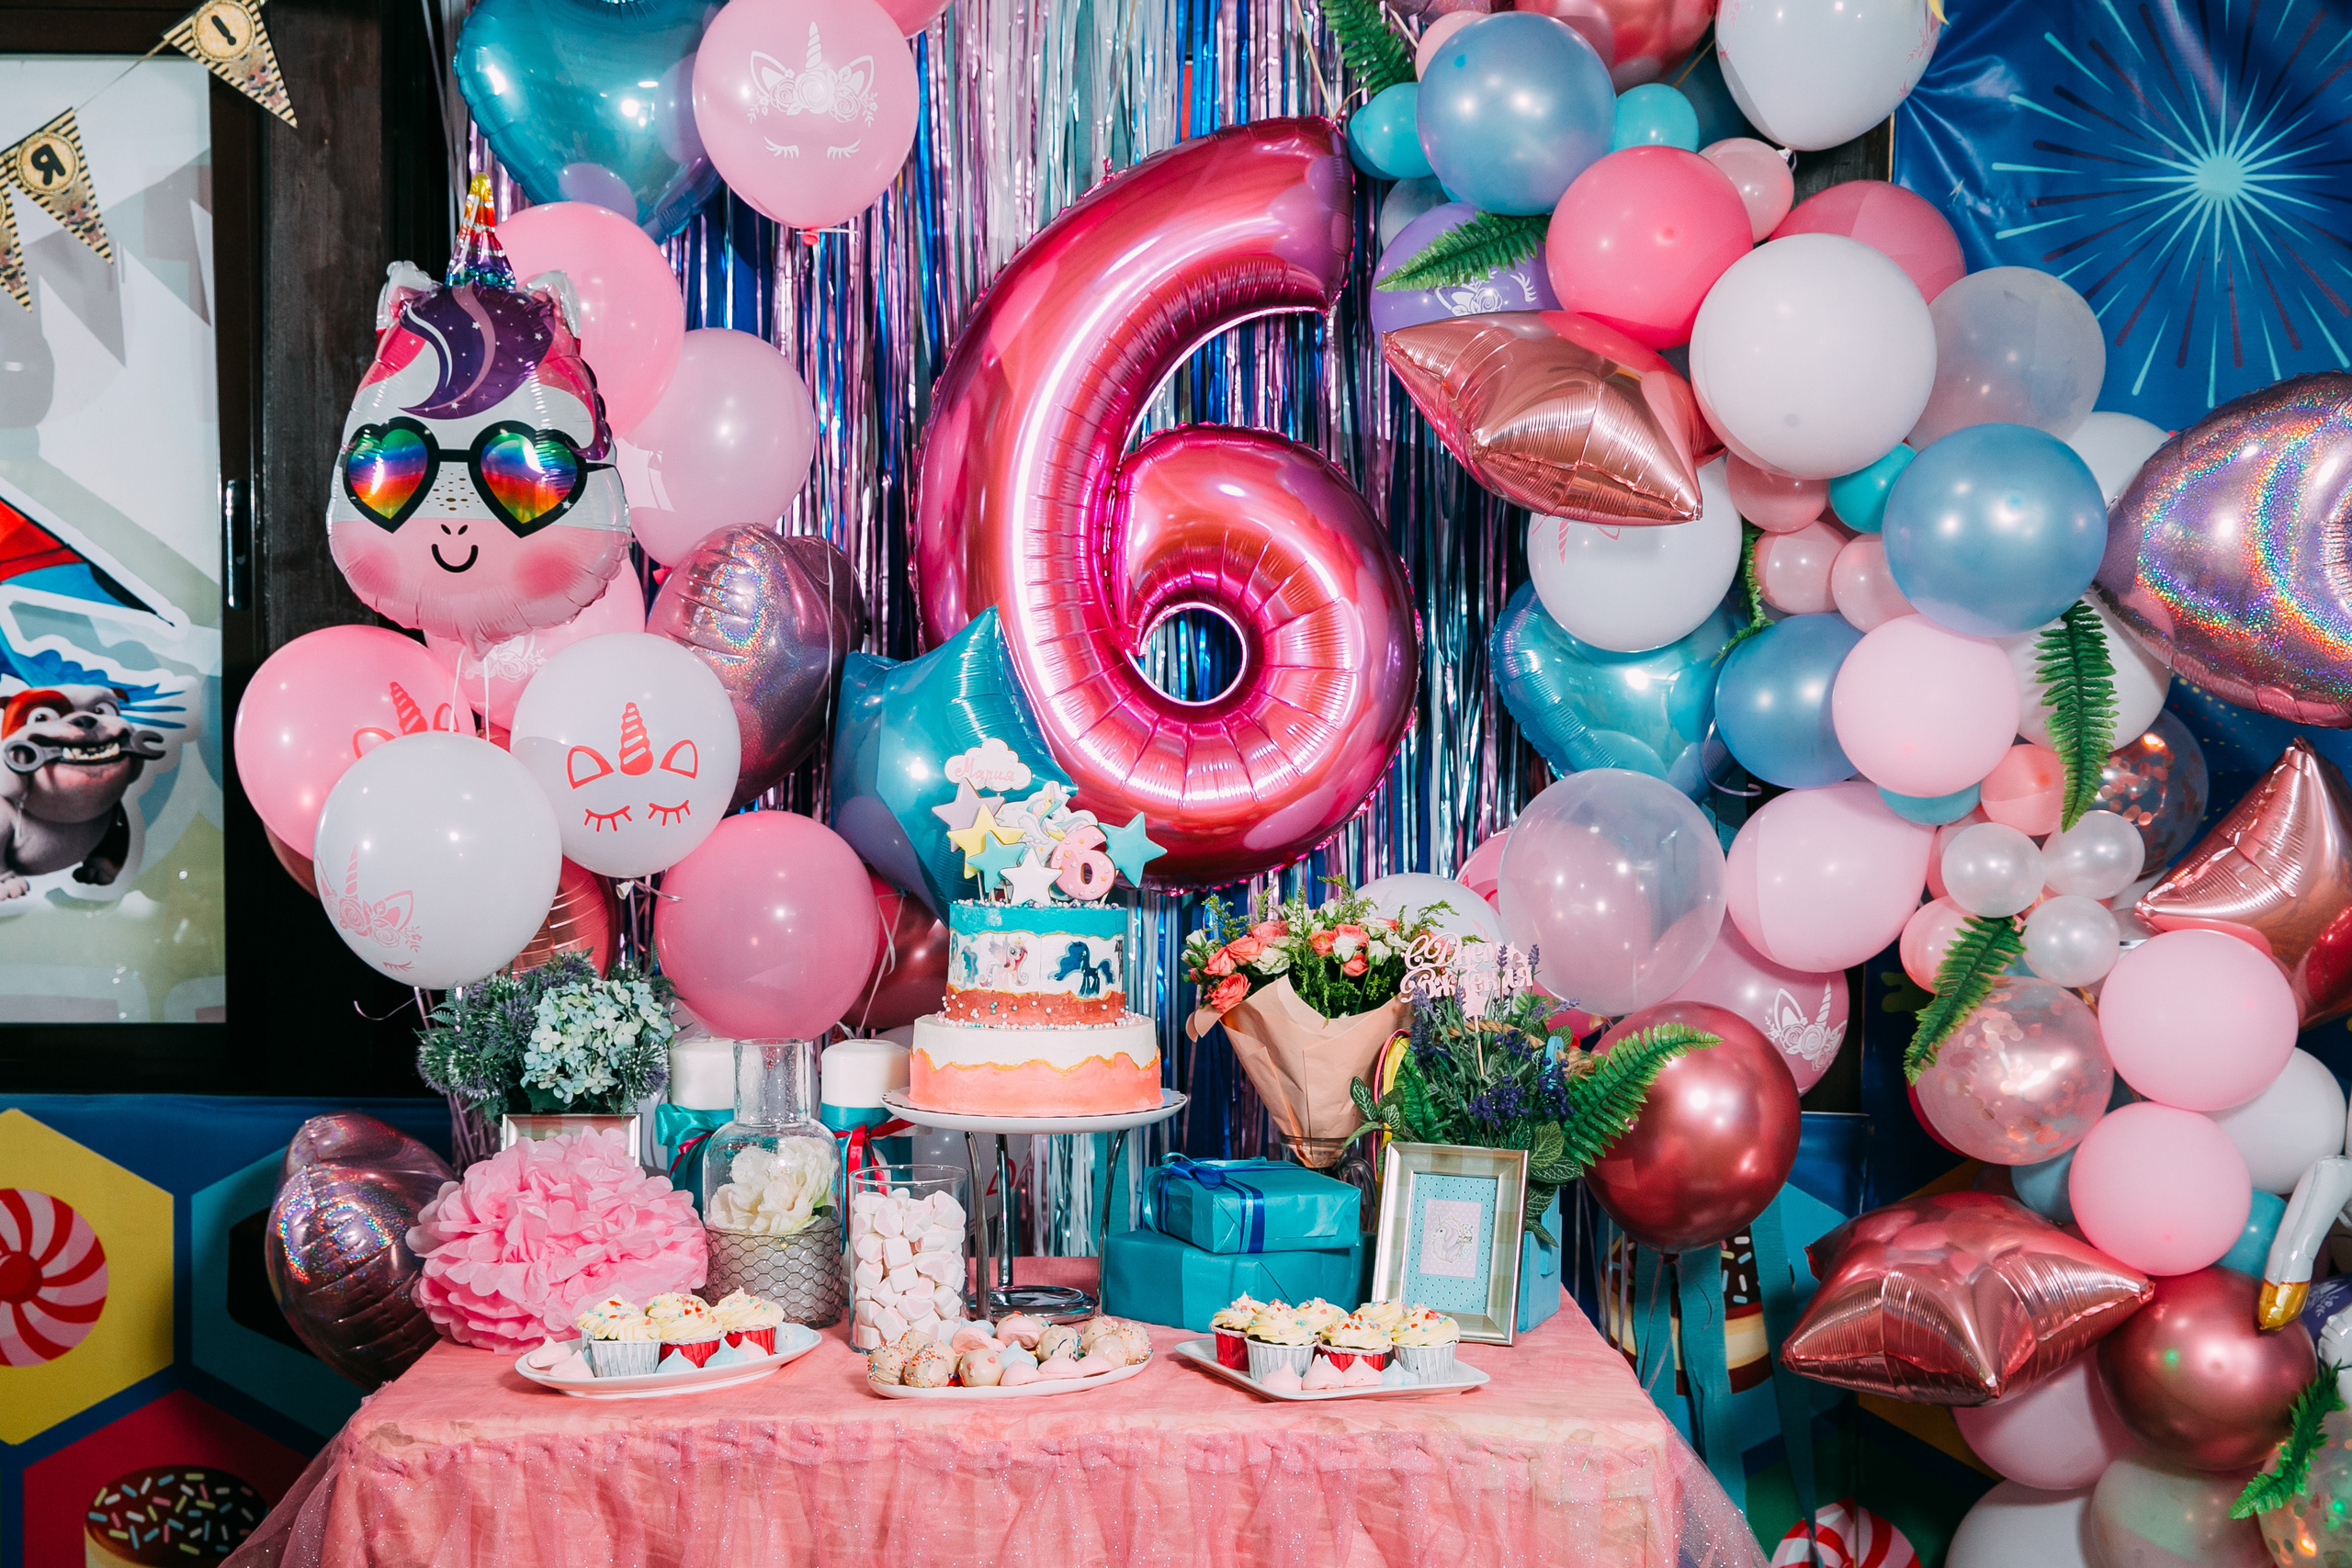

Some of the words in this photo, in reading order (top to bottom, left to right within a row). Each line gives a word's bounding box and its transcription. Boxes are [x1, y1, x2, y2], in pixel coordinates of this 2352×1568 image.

[911, 116, 1423, 896] 6
[955, 757, 1014, 785] Мария
[1050, 824, 1116, 901] 6
